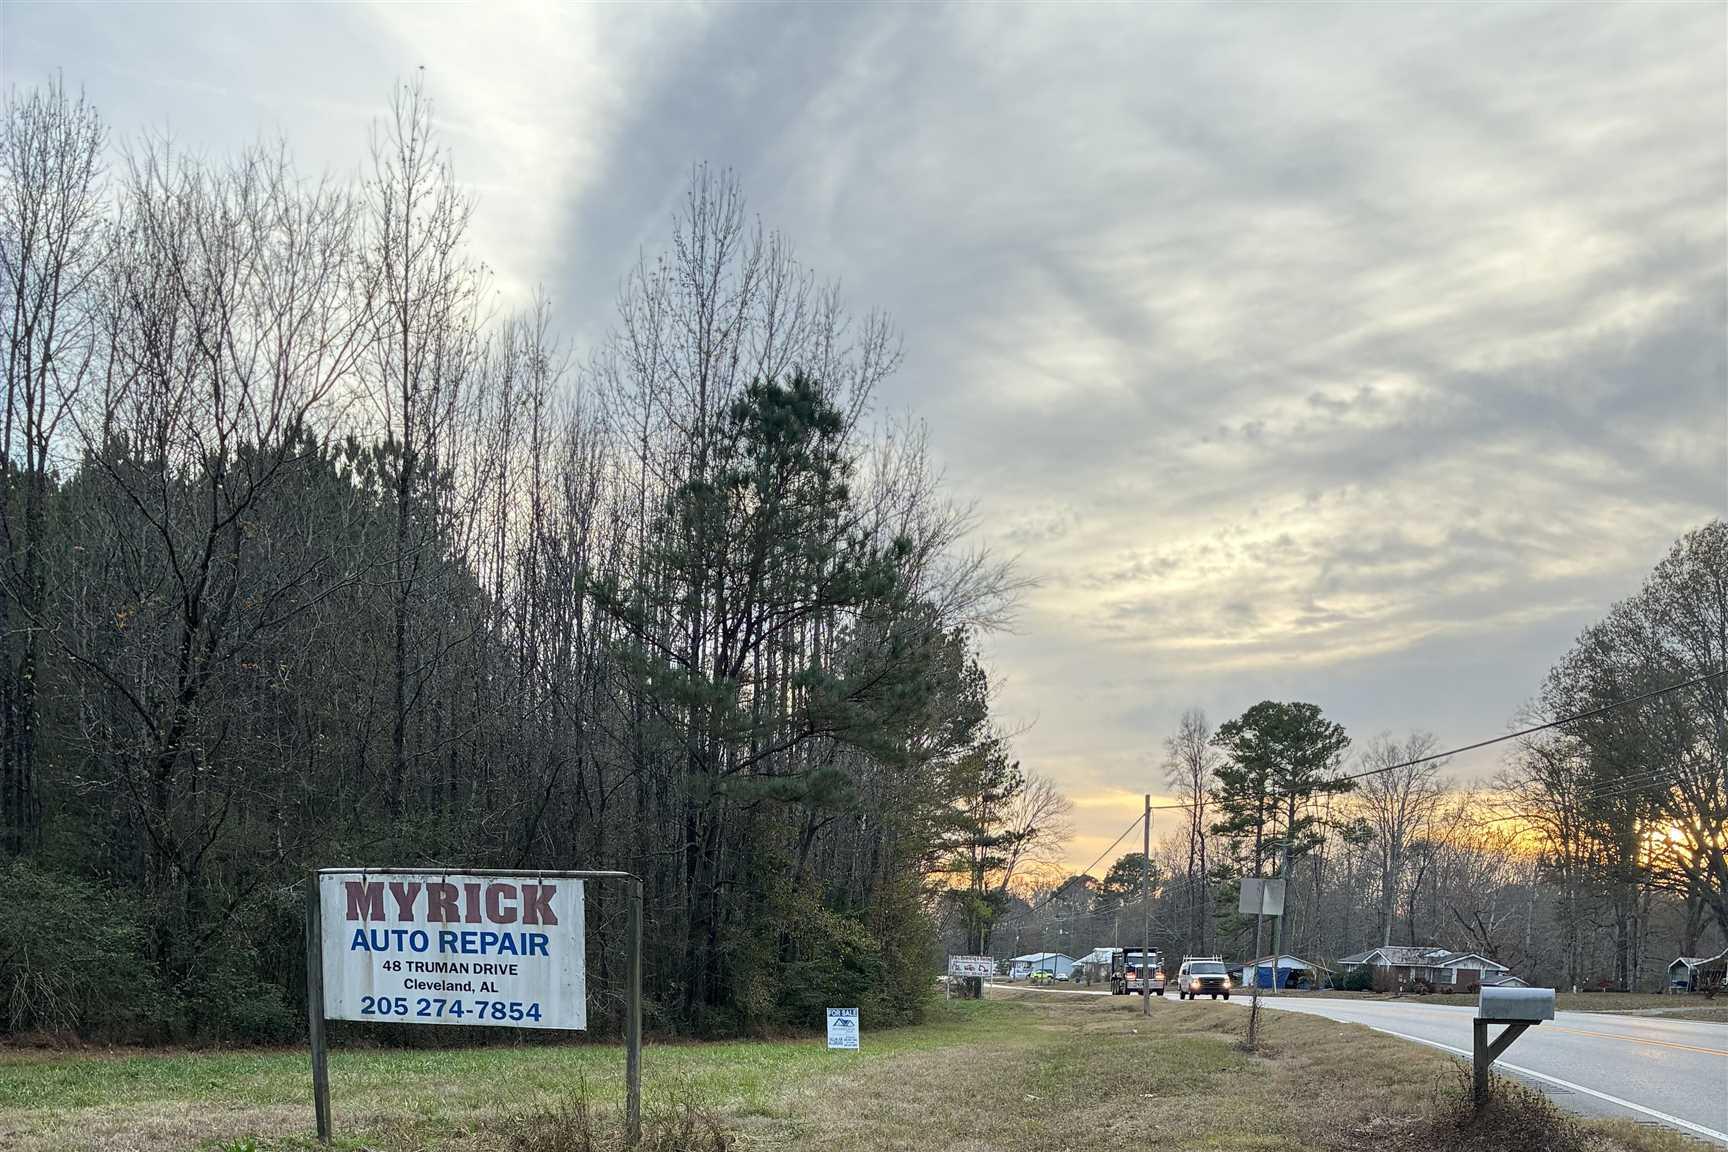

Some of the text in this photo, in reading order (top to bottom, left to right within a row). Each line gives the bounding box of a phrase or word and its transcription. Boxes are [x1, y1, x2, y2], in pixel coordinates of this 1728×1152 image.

[345, 881, 558, 925] MYRICK
[351, 928, 549, 956] AUTO REPAIR
[383, 960, 518, 976] 48 TRUMAN DRIVE
[403, 978, 499, 995] Cleveland, AL
[361, 996, 542, 1022] 205 274-7854
